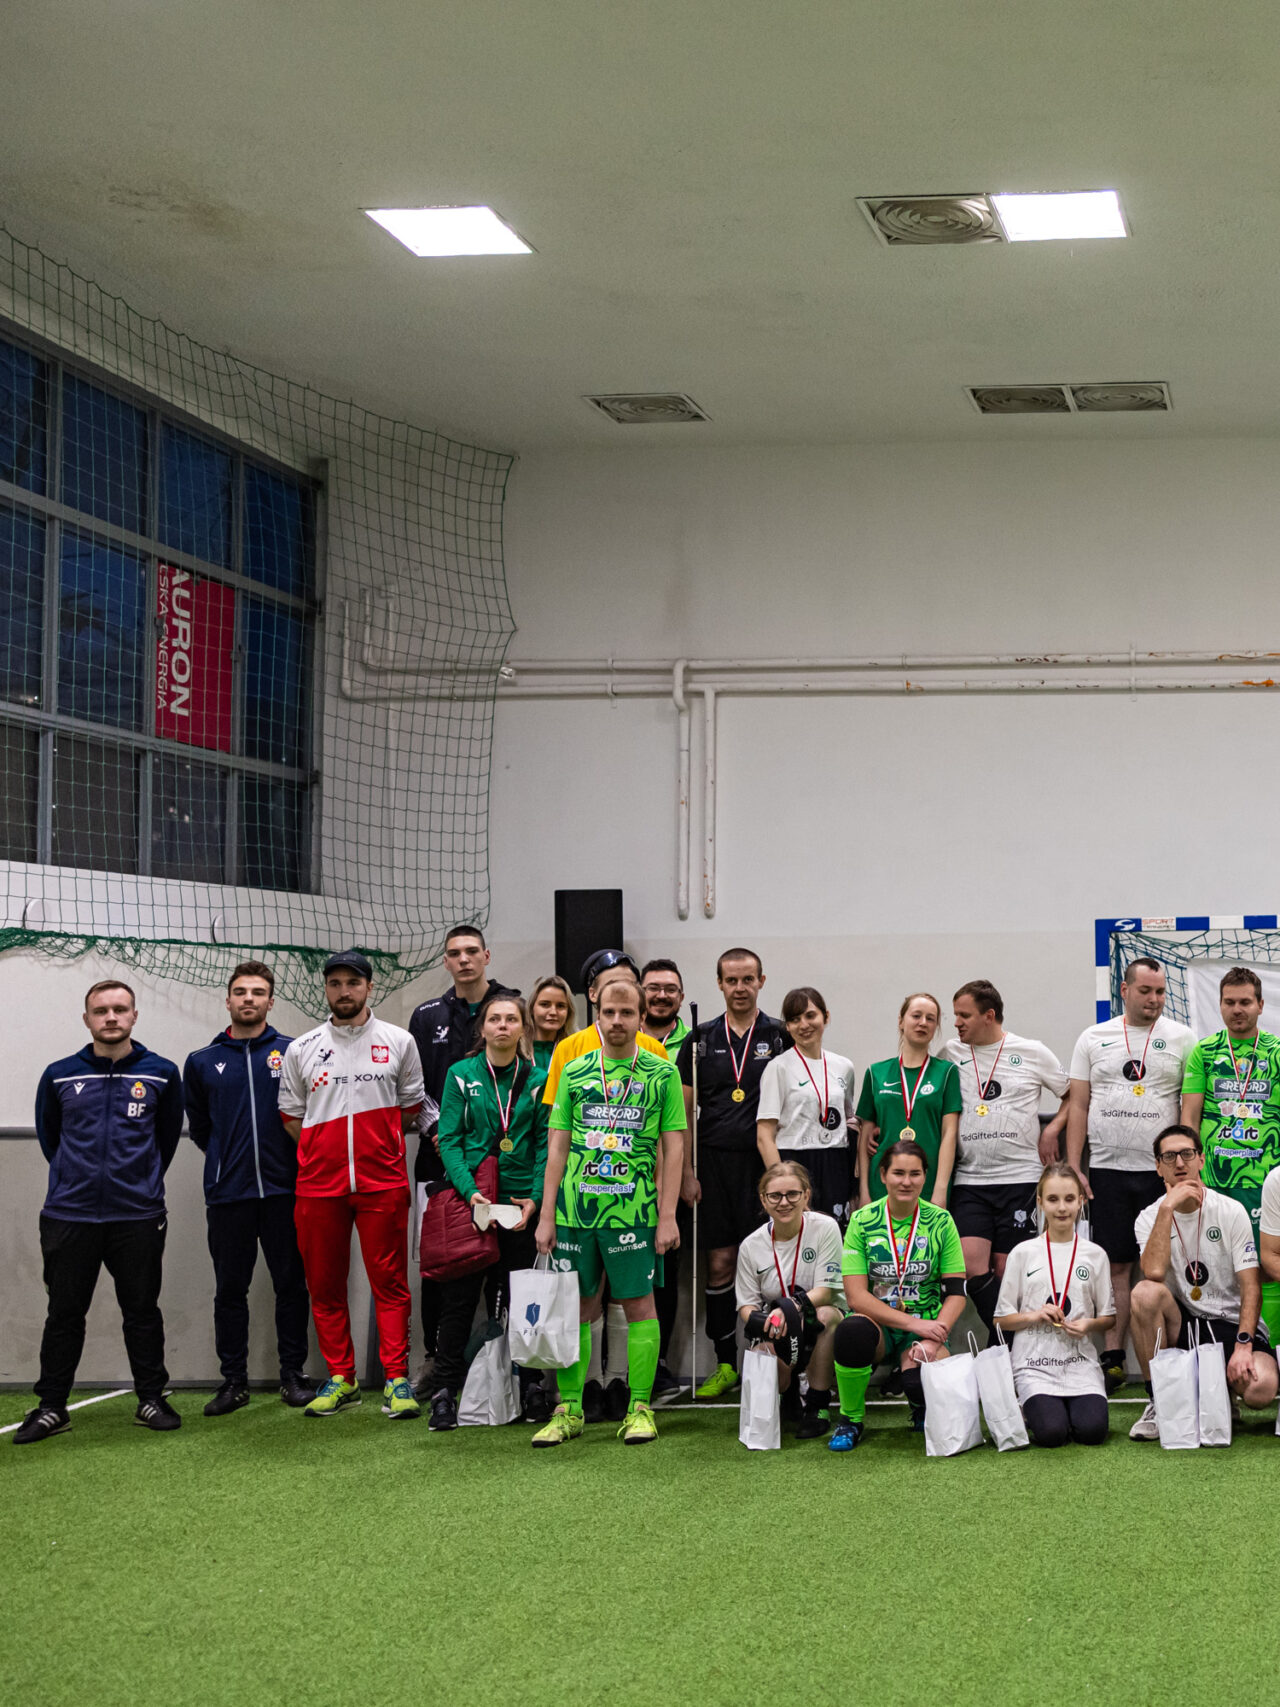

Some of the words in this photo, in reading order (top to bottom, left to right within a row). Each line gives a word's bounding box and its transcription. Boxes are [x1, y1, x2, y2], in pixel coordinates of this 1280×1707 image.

[170, 567, 191, 717] AURON
[127, 1102, 147, 1118] BF
[960, 1131, 1018, 1142] TedGifted.com
[607, 1240, 648, 1254] ScrumSoft
[880, 1262, 927, 1276] REORD
[890, 1285, 919, 1297] ATK
